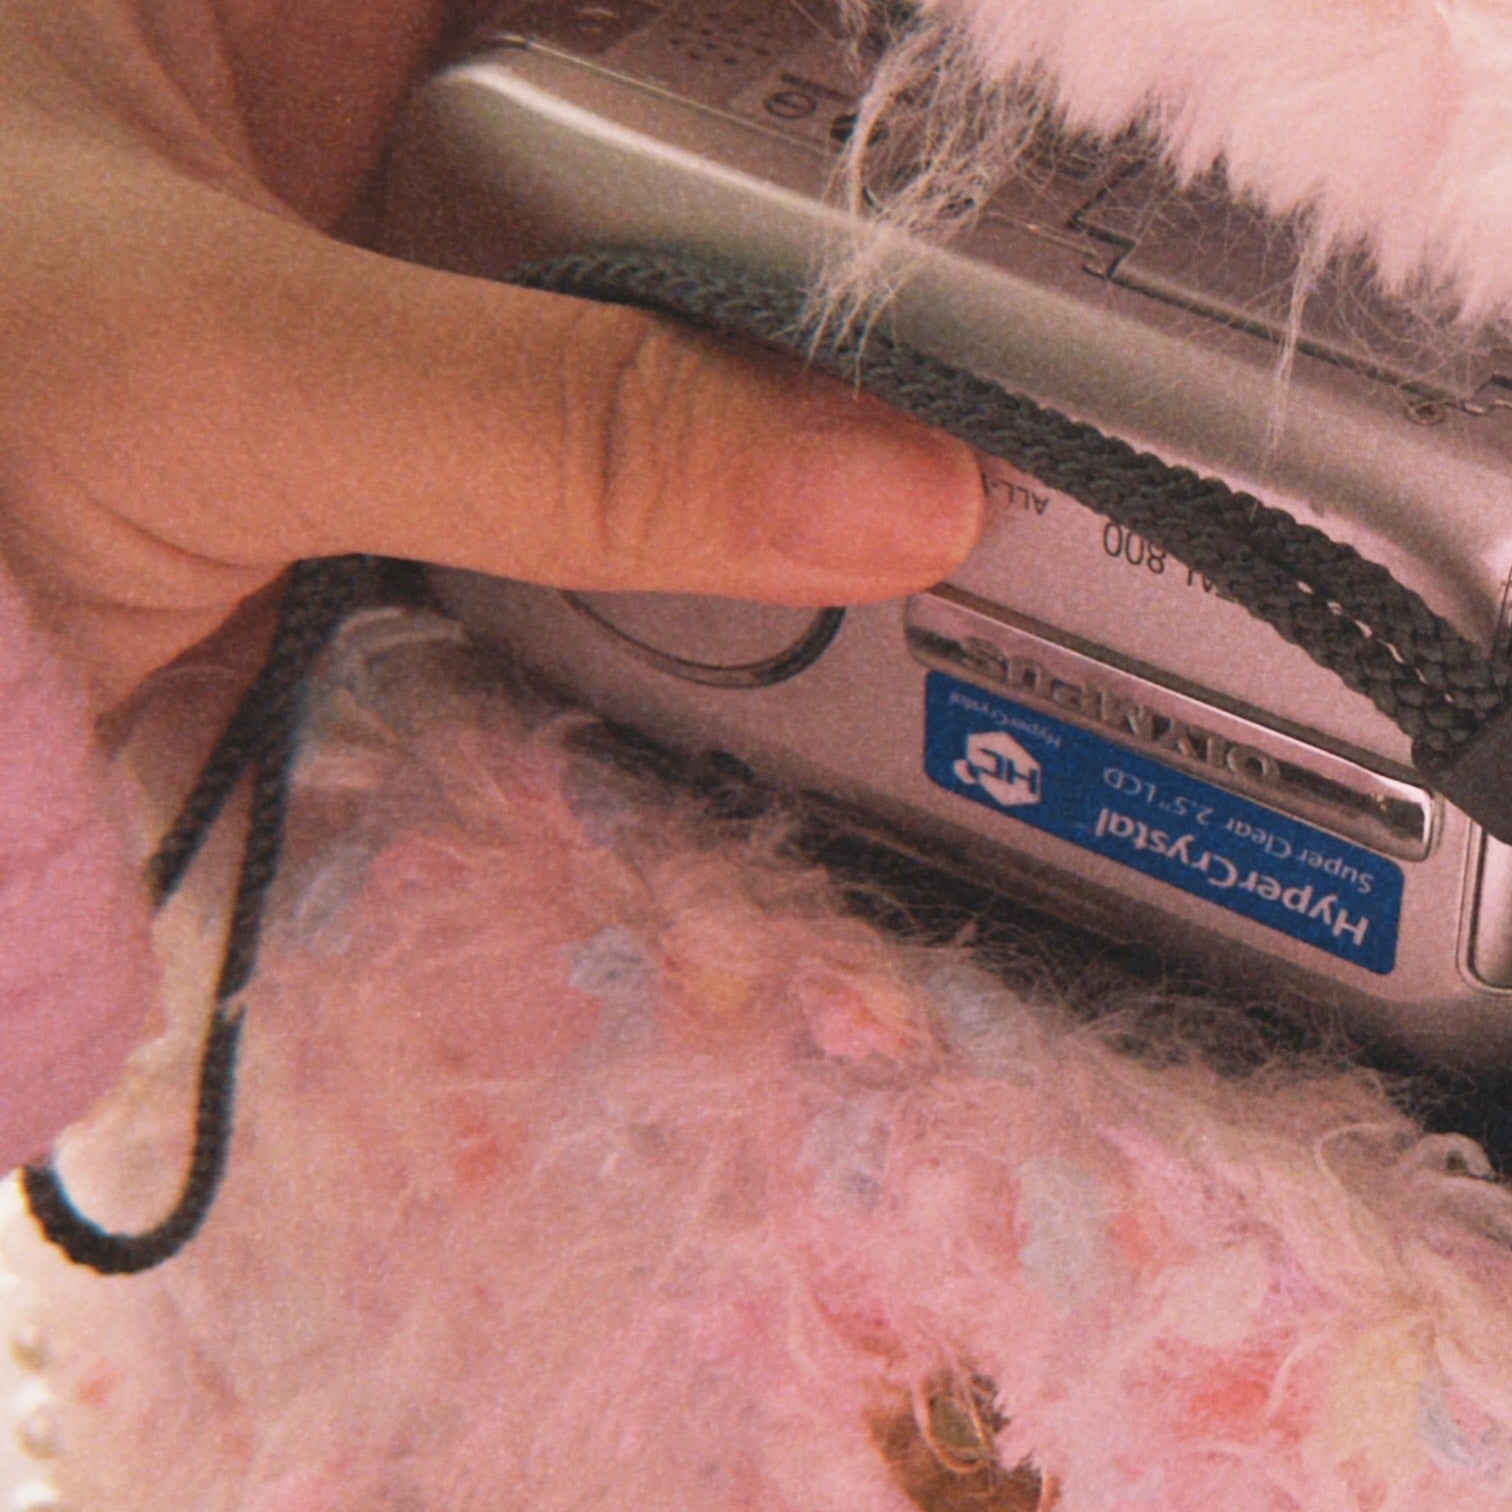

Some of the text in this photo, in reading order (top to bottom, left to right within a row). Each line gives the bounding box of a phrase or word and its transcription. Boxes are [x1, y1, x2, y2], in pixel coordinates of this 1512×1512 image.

[1103, 522, 1166, 574] 800
[949, 691, 1062, 748] HyperCrystal
[962, 636, 1280, 781] OLYMPUS
[1103, 767, 1157, 802] LCD
[1225, 817, 1292, 859] Clear
[1095, 807, 1369, 946] HyperCrystal
[1297, 849, 1374, 894] Super
